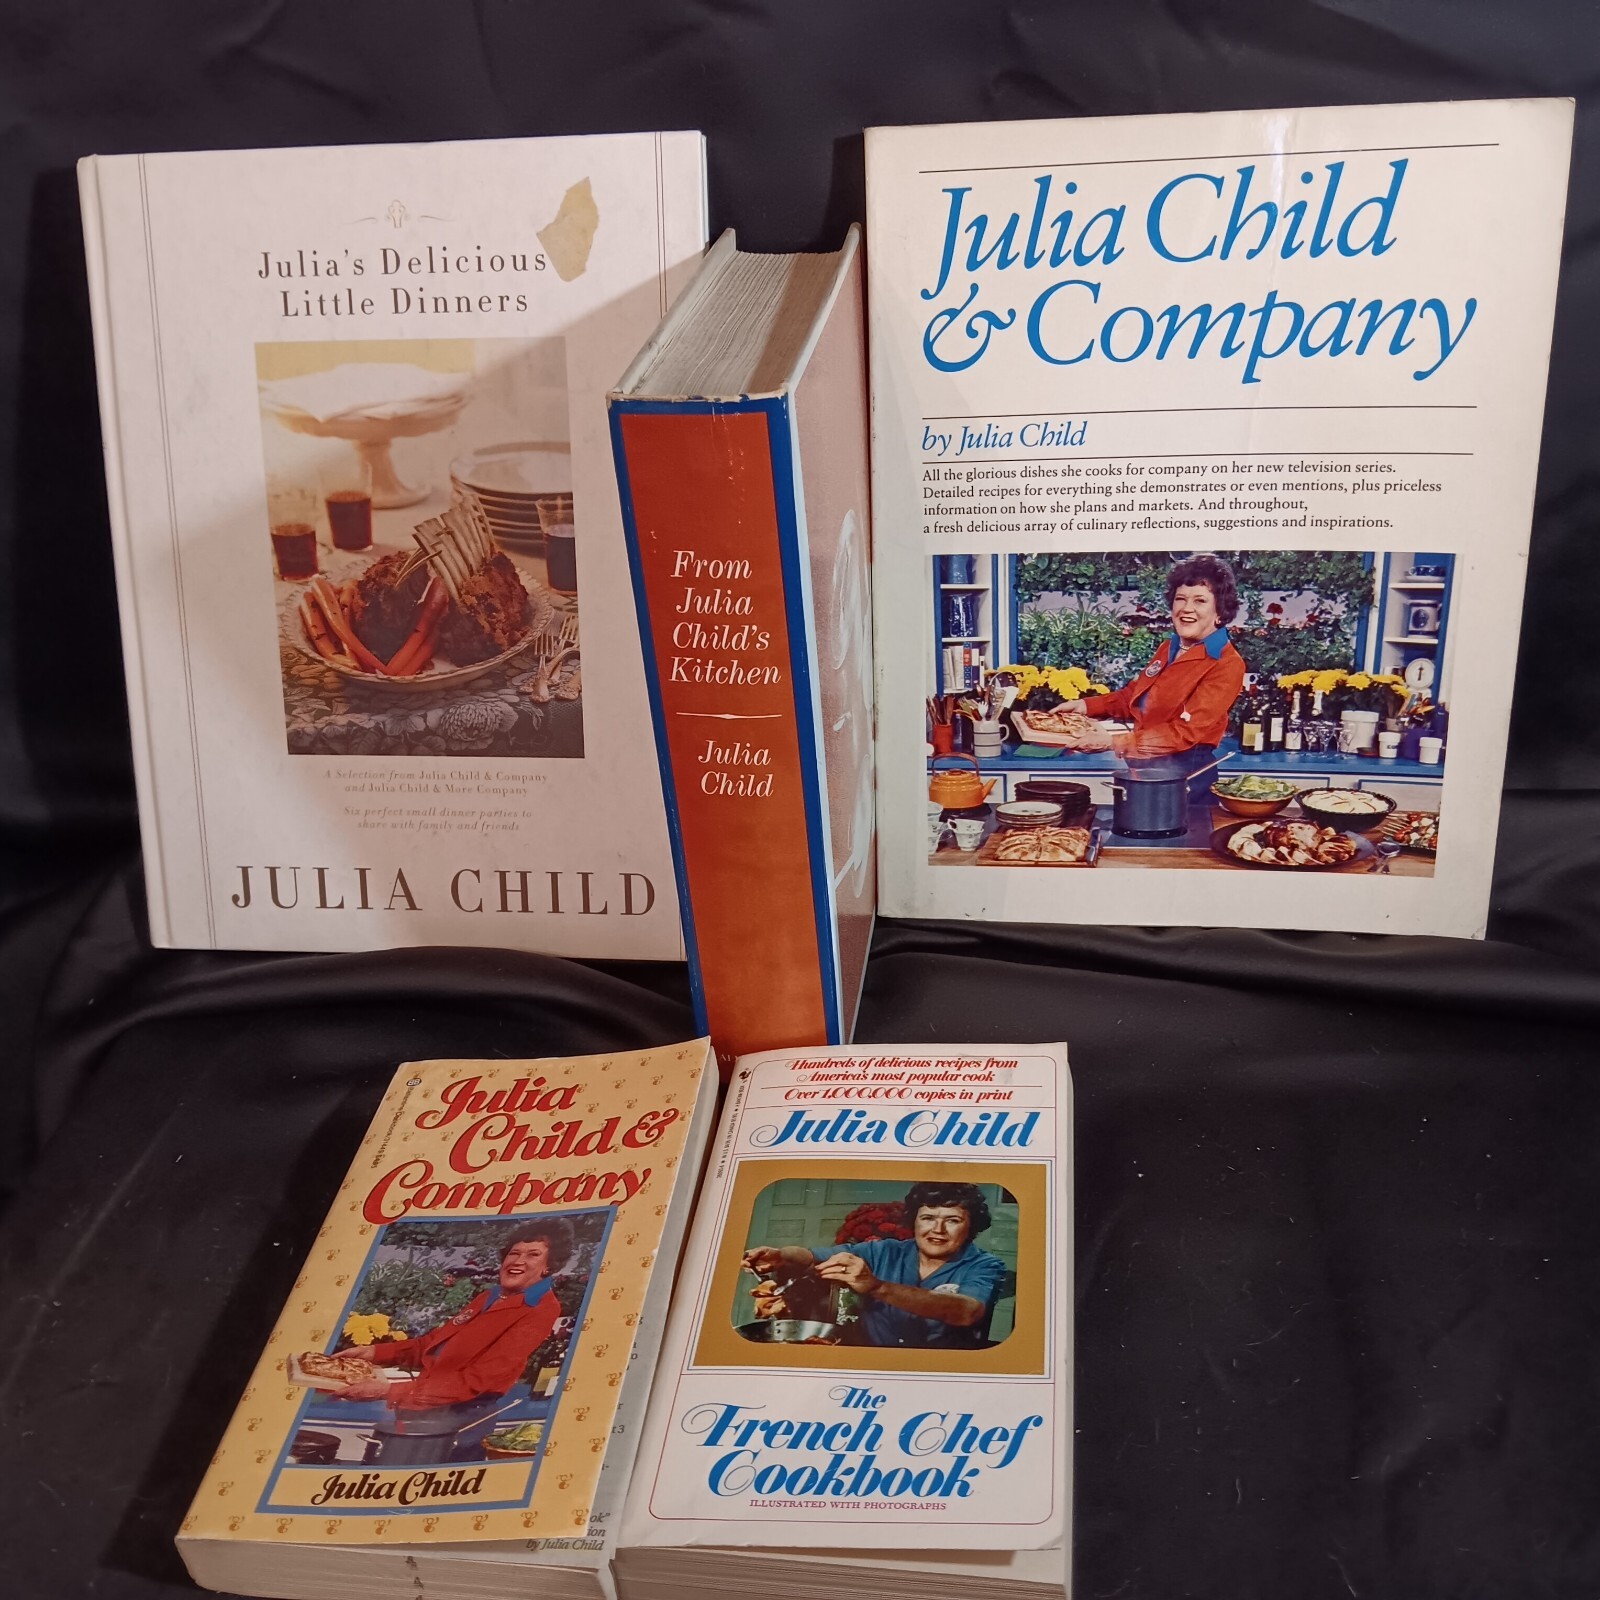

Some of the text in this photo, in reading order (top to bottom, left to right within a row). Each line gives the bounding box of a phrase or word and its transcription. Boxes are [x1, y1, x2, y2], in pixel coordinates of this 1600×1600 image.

[919, 158, 1409, 300] Julia Child
[258, 245, 547, 279] Julia's Delicious
[280, 287, 528, 317] Little Dinners
[922, 279, 1478, 385] & Company
[921, 420, 1088, 456] by Julia Child
[922, 461, 1396, 483] All the glorious dishes she cooks for company on her new television series.
[923, 479, 1442, 500] Detailed recipes for everything she demonstrates or even mentions, plus priceless
[924, 497, 1308, 516] information on how she plans and markets. And throughout,
[923, 515, 1394, 533] a fresh delicious array of culinary reflections, suggestions and inspirations.
[670, 550, 753, 579] From
[675, 587, 754, 616] Julia
[672, 621, 771, 651] Child's
[668, 656, 782, 685] Kitchen
[698, 739, 771, 766] Julia
[335, 769, 386, 780] Selection
[388, 770, 416, 783] from
[418, 771, 447, 780] Julia
[450, 771, 480, 781] Child
[484, 772, 492, 781] &
[496, 772, 548, 784] Company
[344, 784, 529, 797] and Julia Child & More Company
[700, 770, 774, 798] Child
[343, 806, 533, 820] Six perfect small dinner parties to
[356, 820, 520, 834] share with family and friends
[231, 865, 657, 916] JULIA CHILD
[785, 1057, 1018, 1071] Hundreds of delicious recipes from
[871, 1072, 905, 1081] most
[906, 1071, 961, 1084] popular
[962, 1071, 995, 1081] cook
[414, 1075, 580, 1130] Julia
[785, 1088, 819, 1100] Over
[915, 1089, 956, 1102] copies
[959, 1089, 973, 1100] in
[975, 1089, 1013, 1103] print
[449, 1112, 622, 1175] Child
[621, 1107, 680, 1149] &
[750, 1109, 888, 1148] Julia
[894, 1109, 1041, 1148] Child
[362, 1159, 652, 1225] Company
[828, 1385, 887, 1409] The
[681, 1403, 1043, 1469] French Chef
[311, 1468, 487, 1506] Julia Child
[708, 1449, 981, 1497] Cookbook
[750, 1499, 947, 1511] ILLUSTRATED WITH PHOTOGRAPHS
[525, 1539, 604, 1551] by Julia Child
